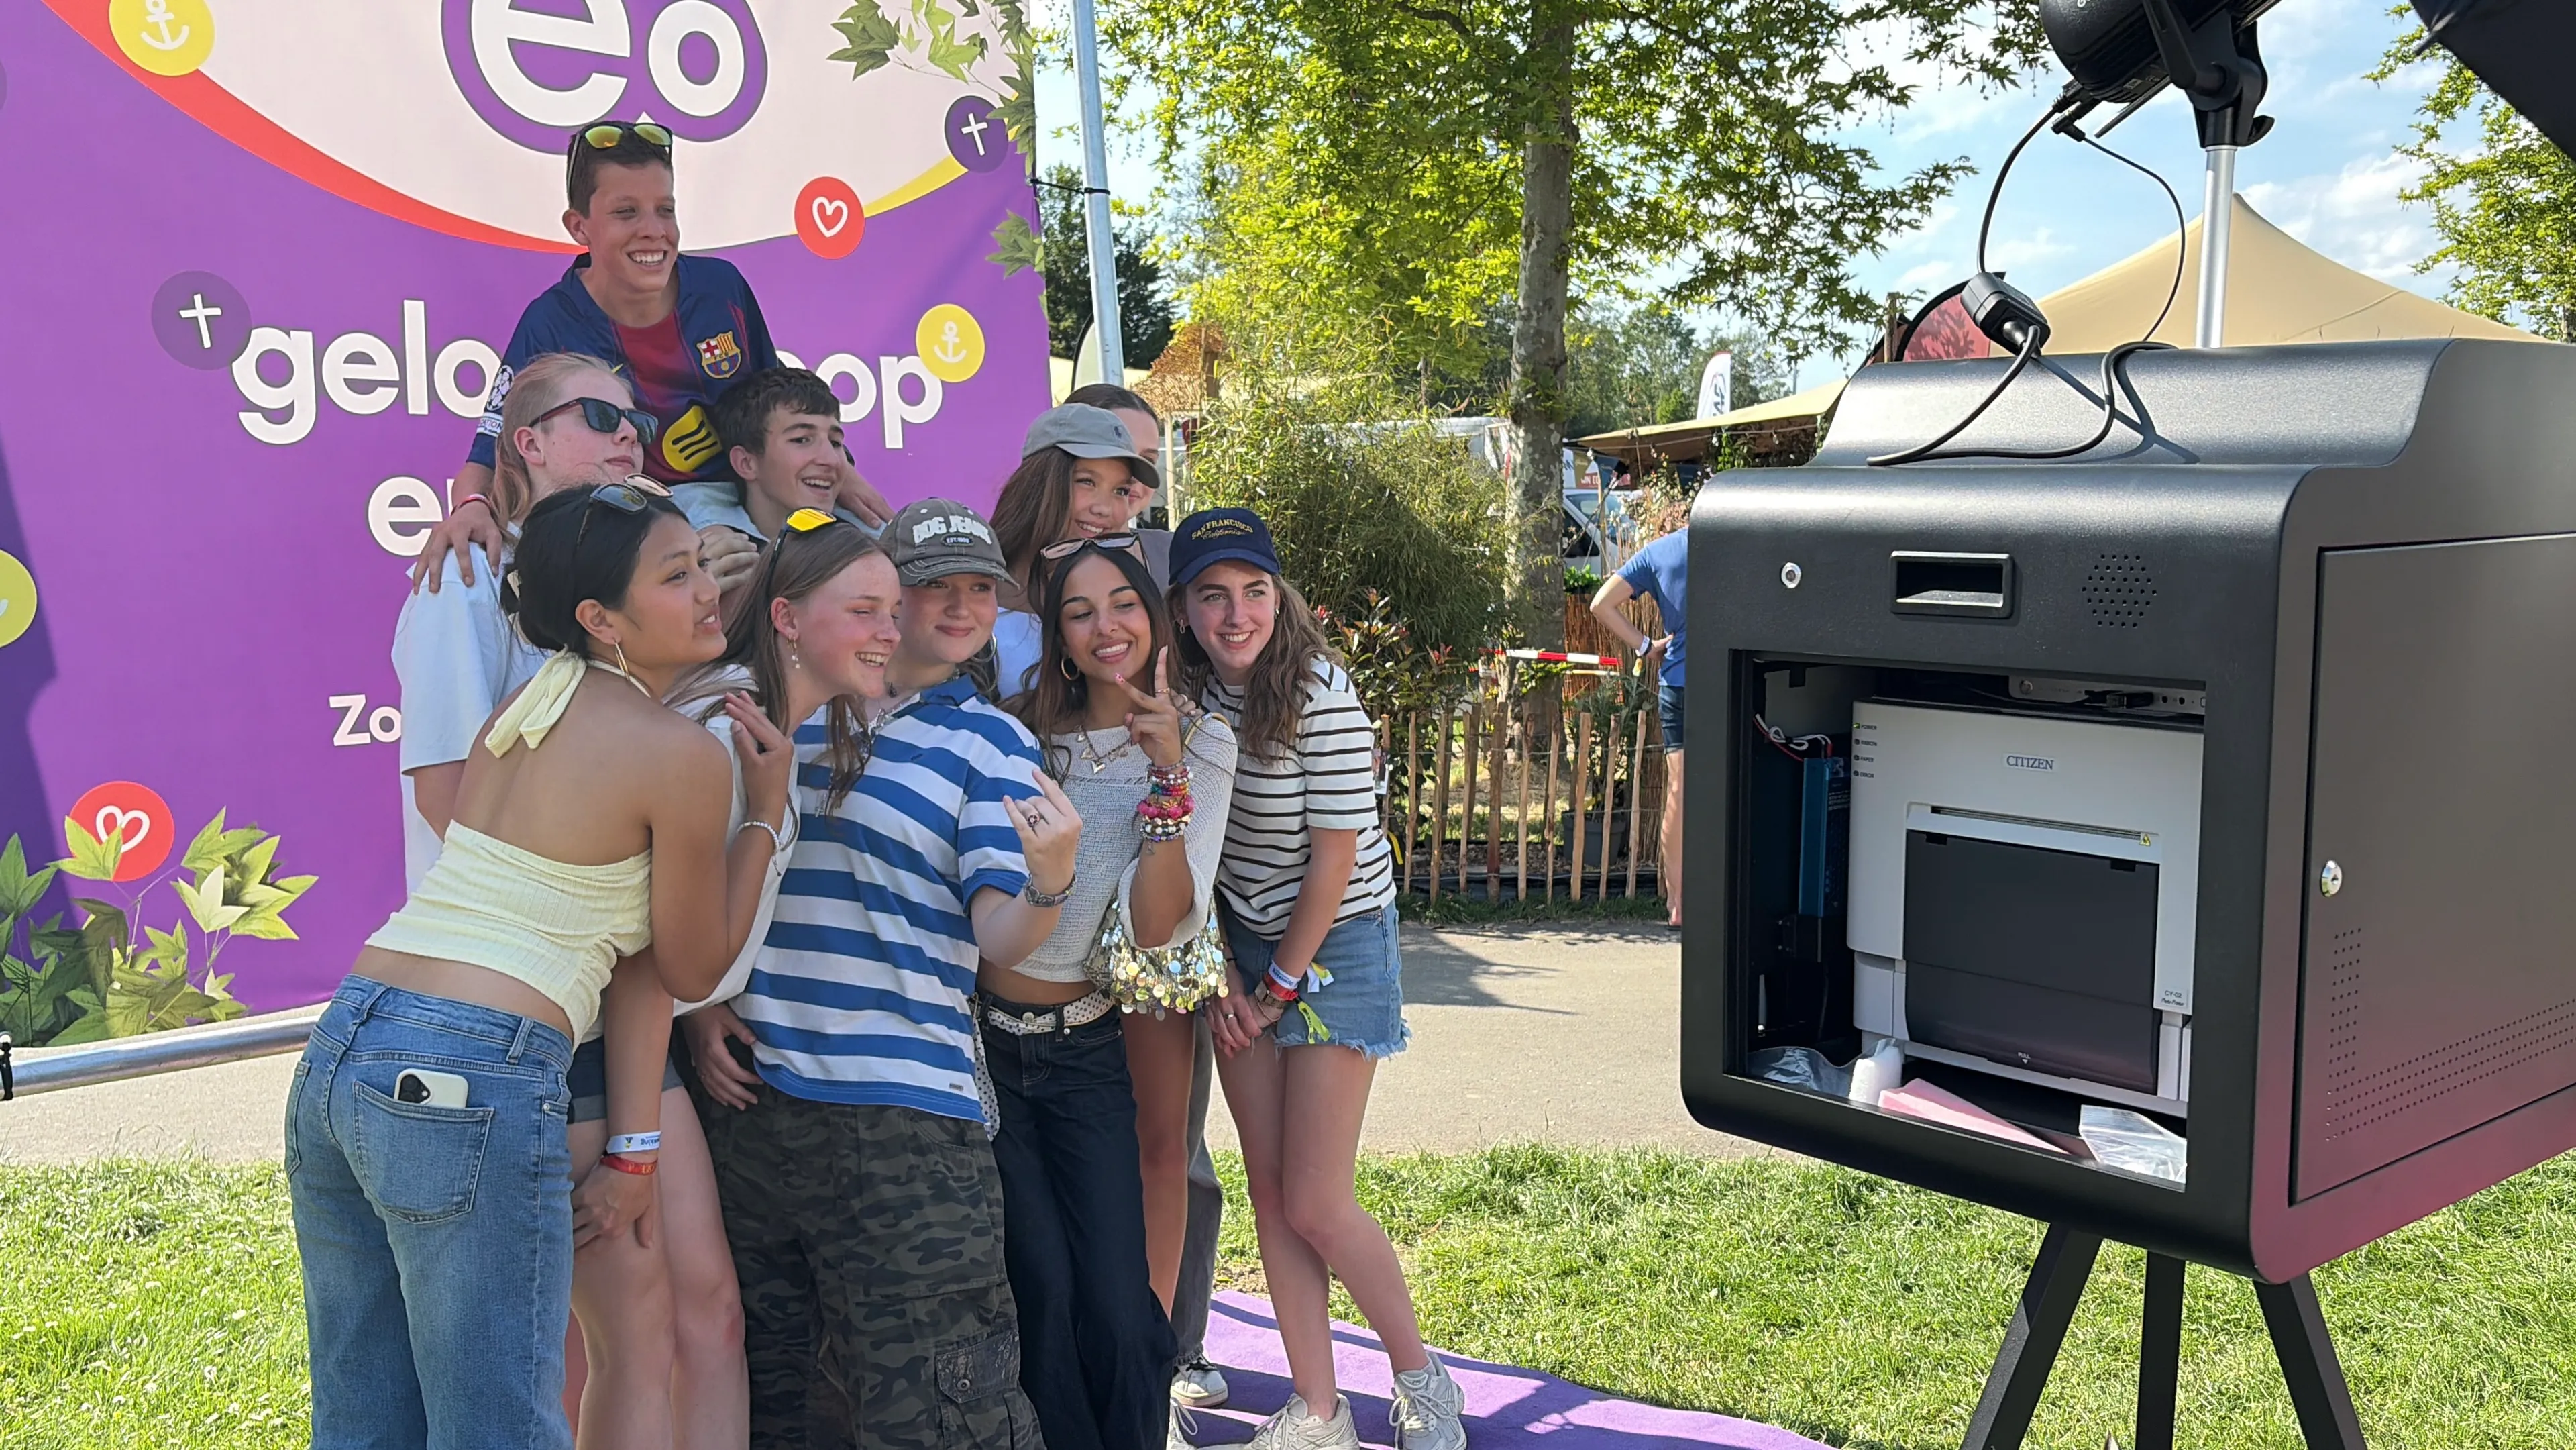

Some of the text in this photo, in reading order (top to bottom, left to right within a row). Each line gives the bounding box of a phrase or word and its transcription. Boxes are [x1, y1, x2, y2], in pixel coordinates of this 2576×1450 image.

[471, 0, 744, 126] eo
[368, 476, 455, 556] e
[1191, 519, 1254, 540] SAN FRANCISCO
[2006, 755, 2054, 770] CITIZEN
[2017, 1051, 2031, 1059] PULL
